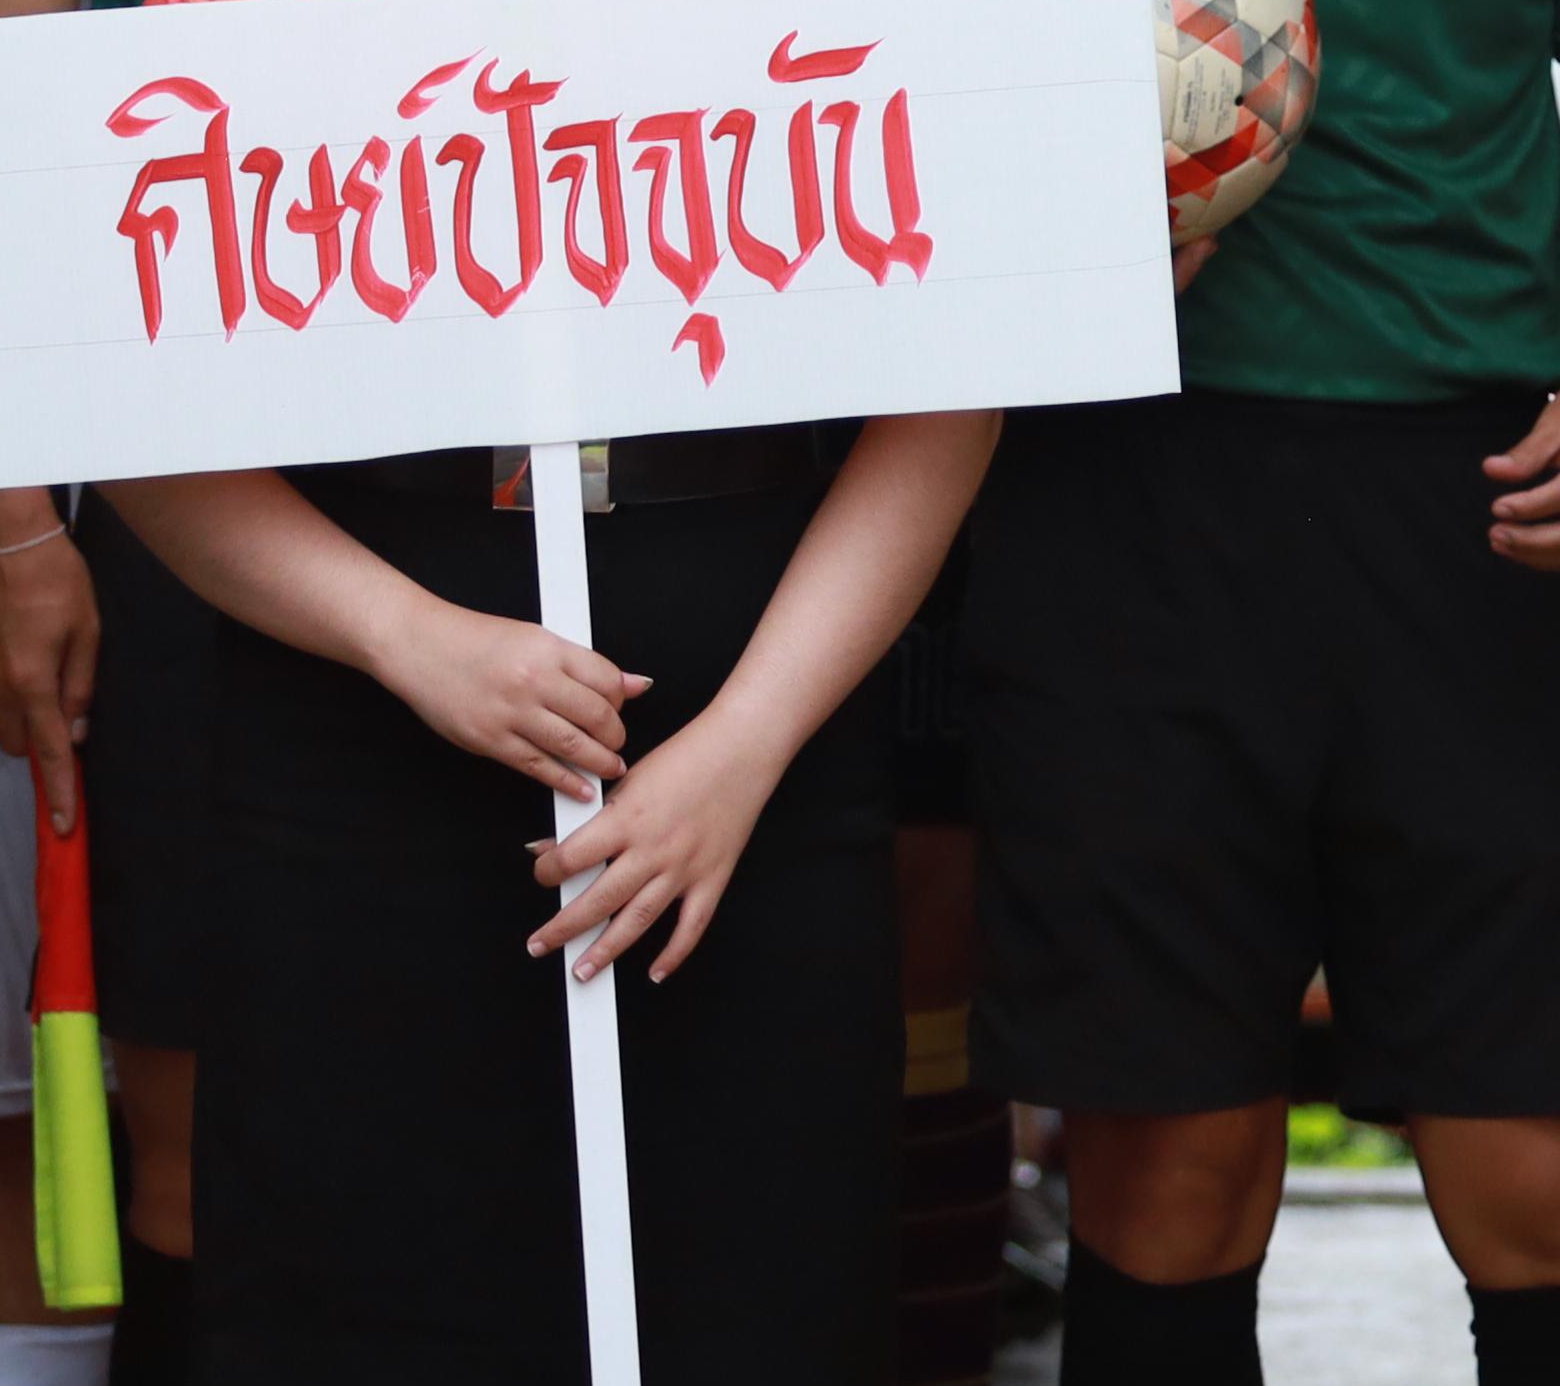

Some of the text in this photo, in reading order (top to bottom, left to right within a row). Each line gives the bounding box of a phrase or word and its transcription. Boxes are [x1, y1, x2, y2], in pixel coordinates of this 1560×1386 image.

[104, 29, 935, 388] ศิษย์ปัจจุบัน
